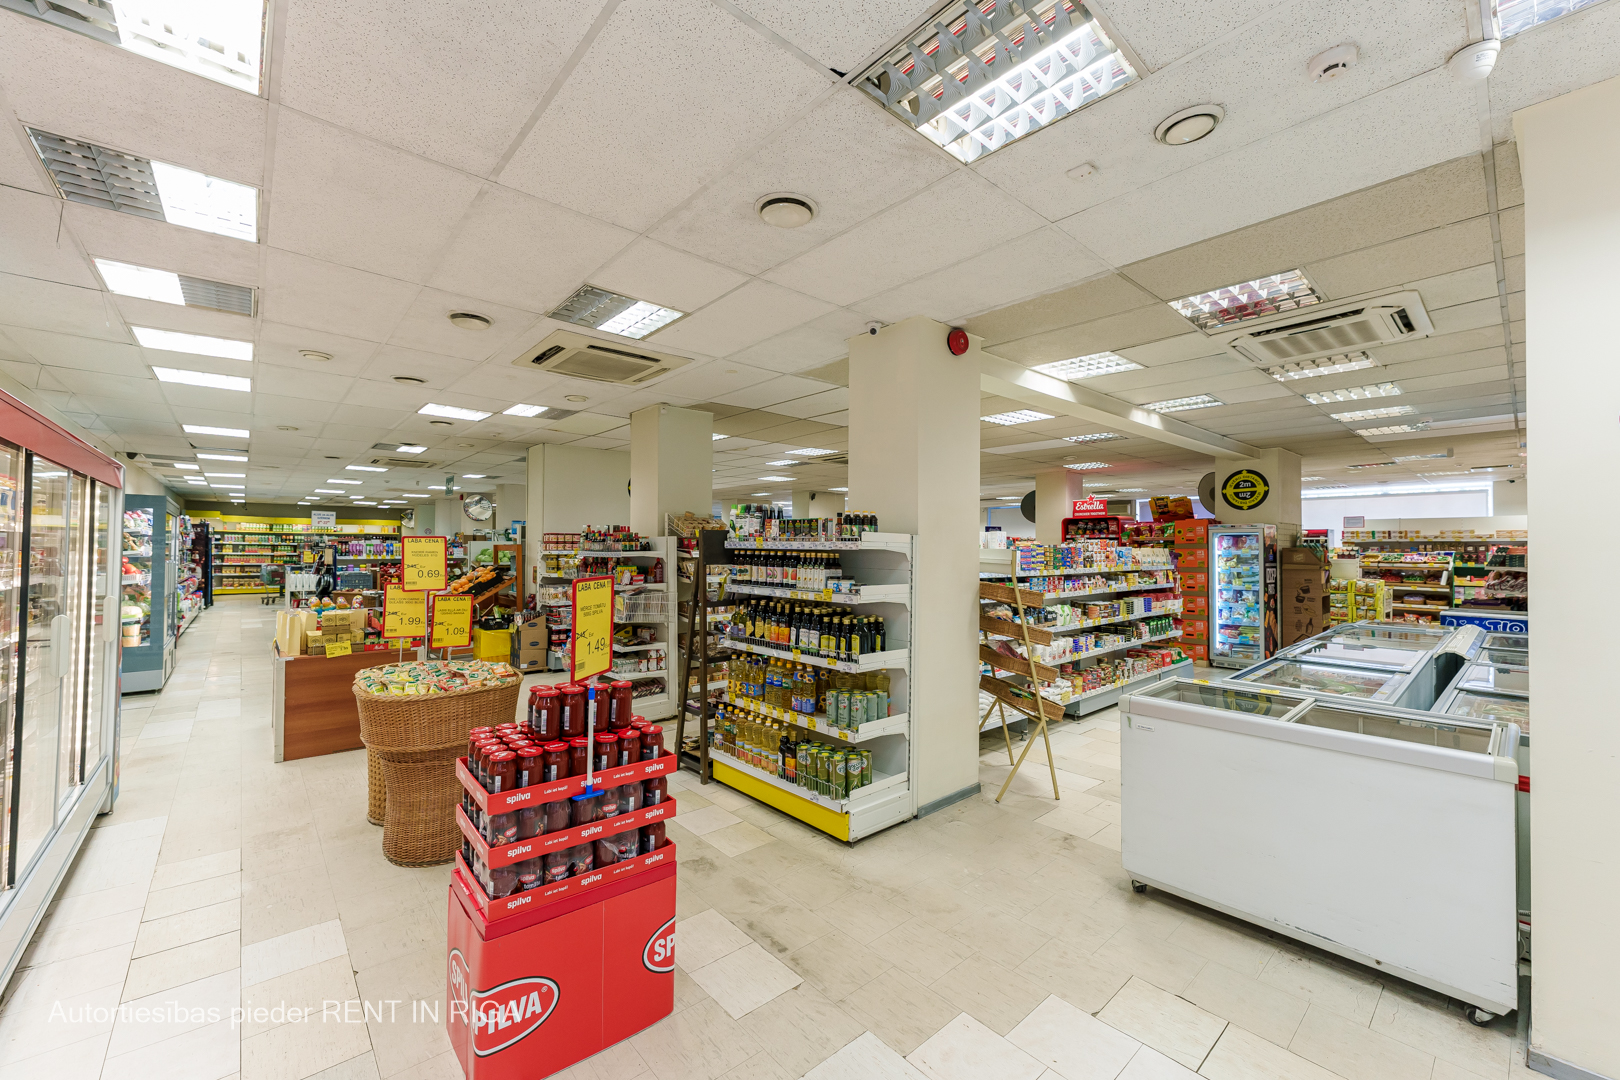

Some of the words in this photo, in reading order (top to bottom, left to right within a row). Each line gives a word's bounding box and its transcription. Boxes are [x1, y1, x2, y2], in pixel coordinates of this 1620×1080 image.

[1076, 501, 1104, 510] Estrella
[418, 570, 440, 578] 0.69
[578, 583, 591, 592] LABA
[593, 581, 606, 589] CENA
[399, 617, 420, 625] 1.99
[446, 627, 465, 635] 1.09
[587, 637, 605, 655] 1.49
[645, 763, 664, 773] spilva
[506, 791, 531, 804] spilva
[645, 808, 664, 819] spilva
[581, 826, 602, 837] spilva
[507, 844, 532, 857] spilva
[645, 854, 664, 864] spilva
[552, 866, 565, 874] spilva
[581, 874, 602, 886] spilva
[507, 896, 532, 909] spilva
